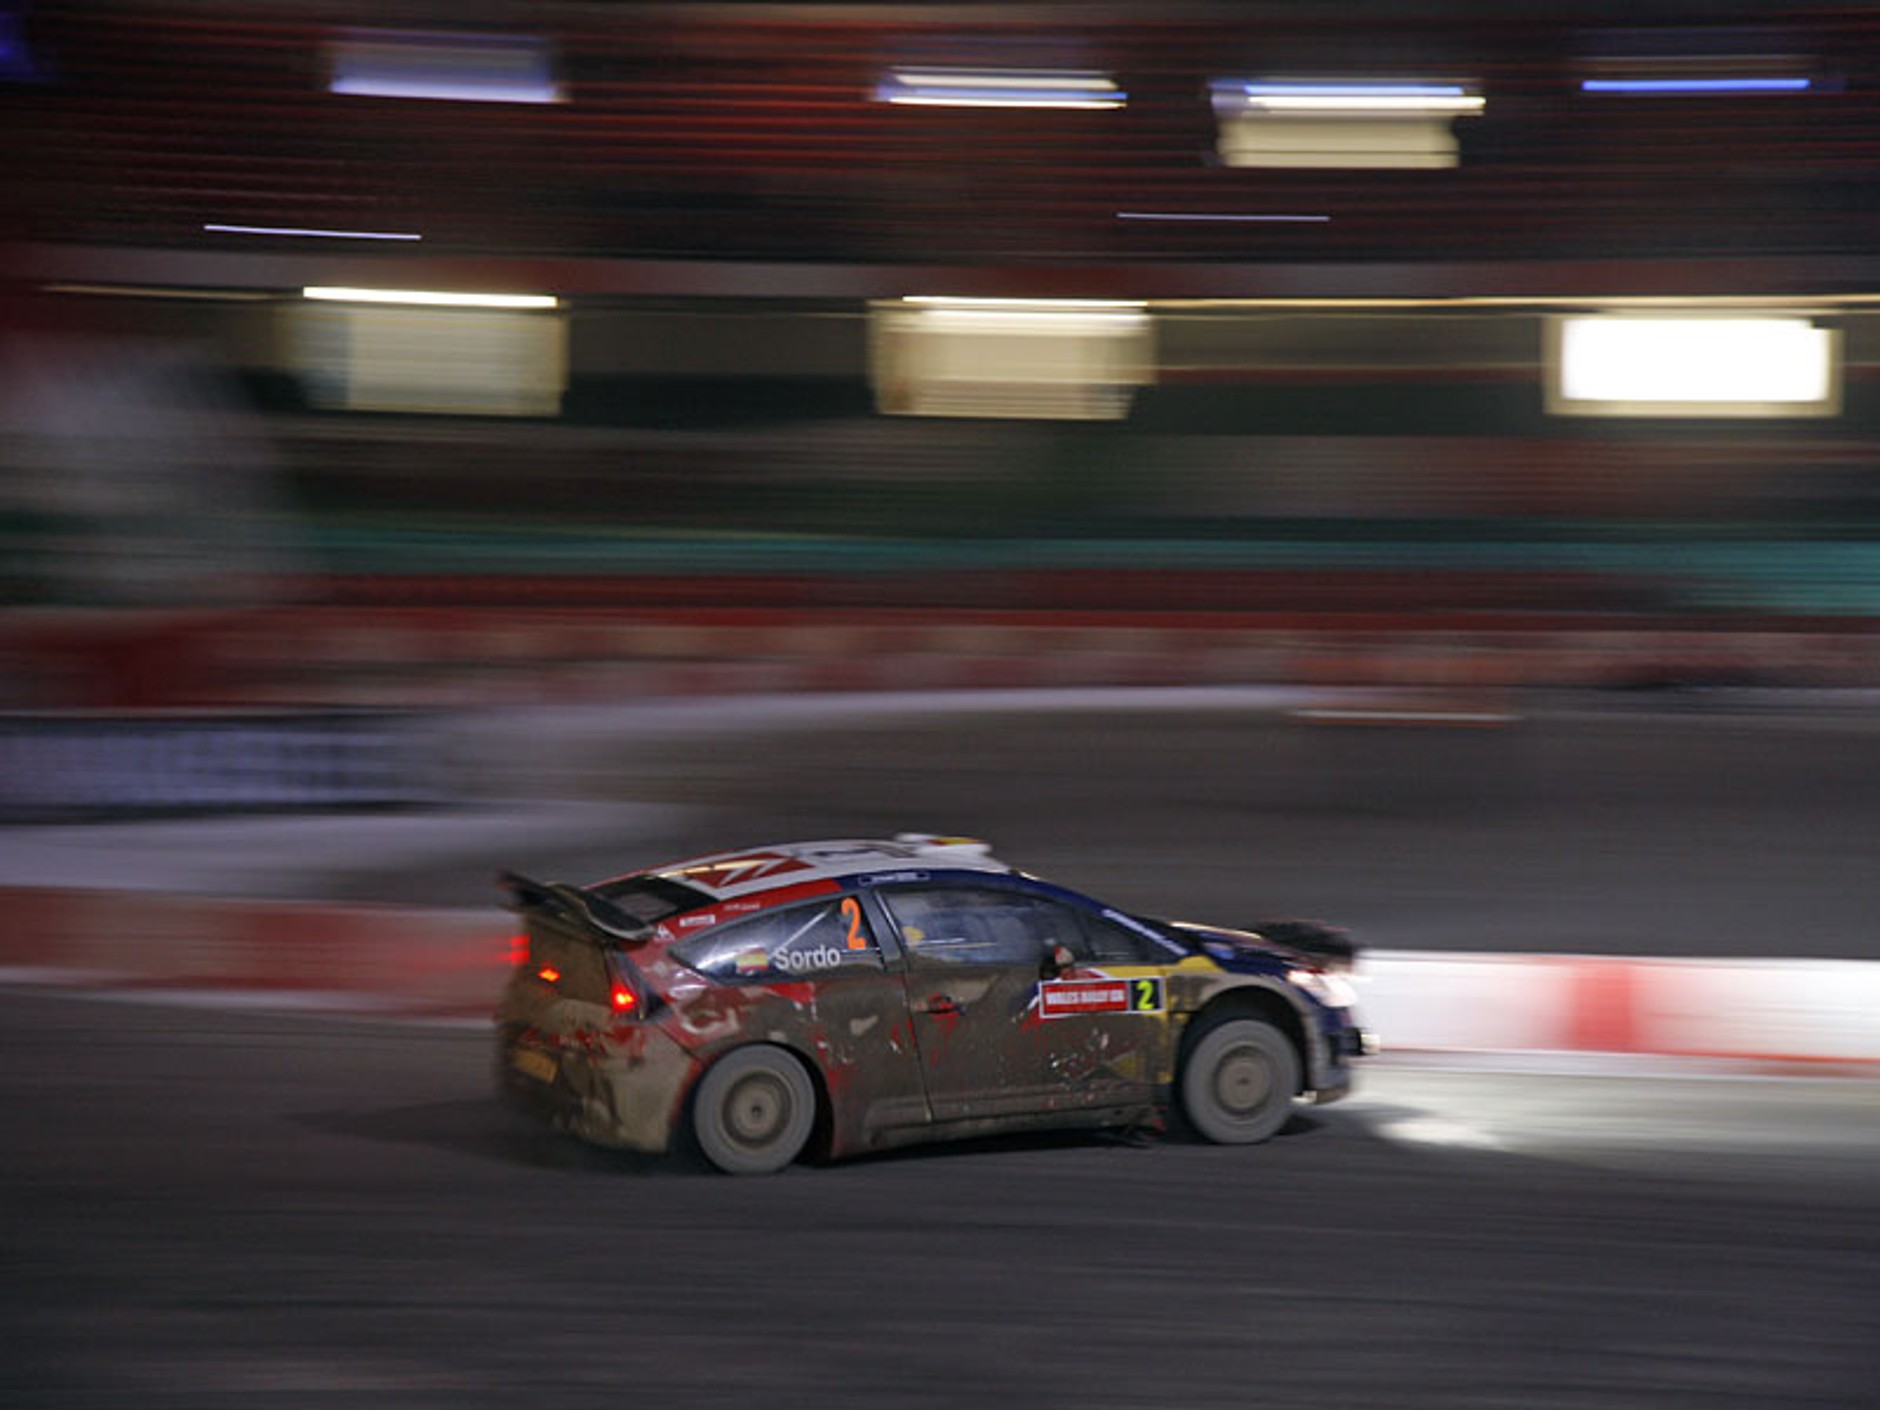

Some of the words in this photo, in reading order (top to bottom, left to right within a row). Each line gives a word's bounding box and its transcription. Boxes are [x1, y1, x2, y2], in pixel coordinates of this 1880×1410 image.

[841, 897, 867, 950] 2
[774, 944, 841, 972] Sordo
[1136, 980, 1154, 1010] 2
